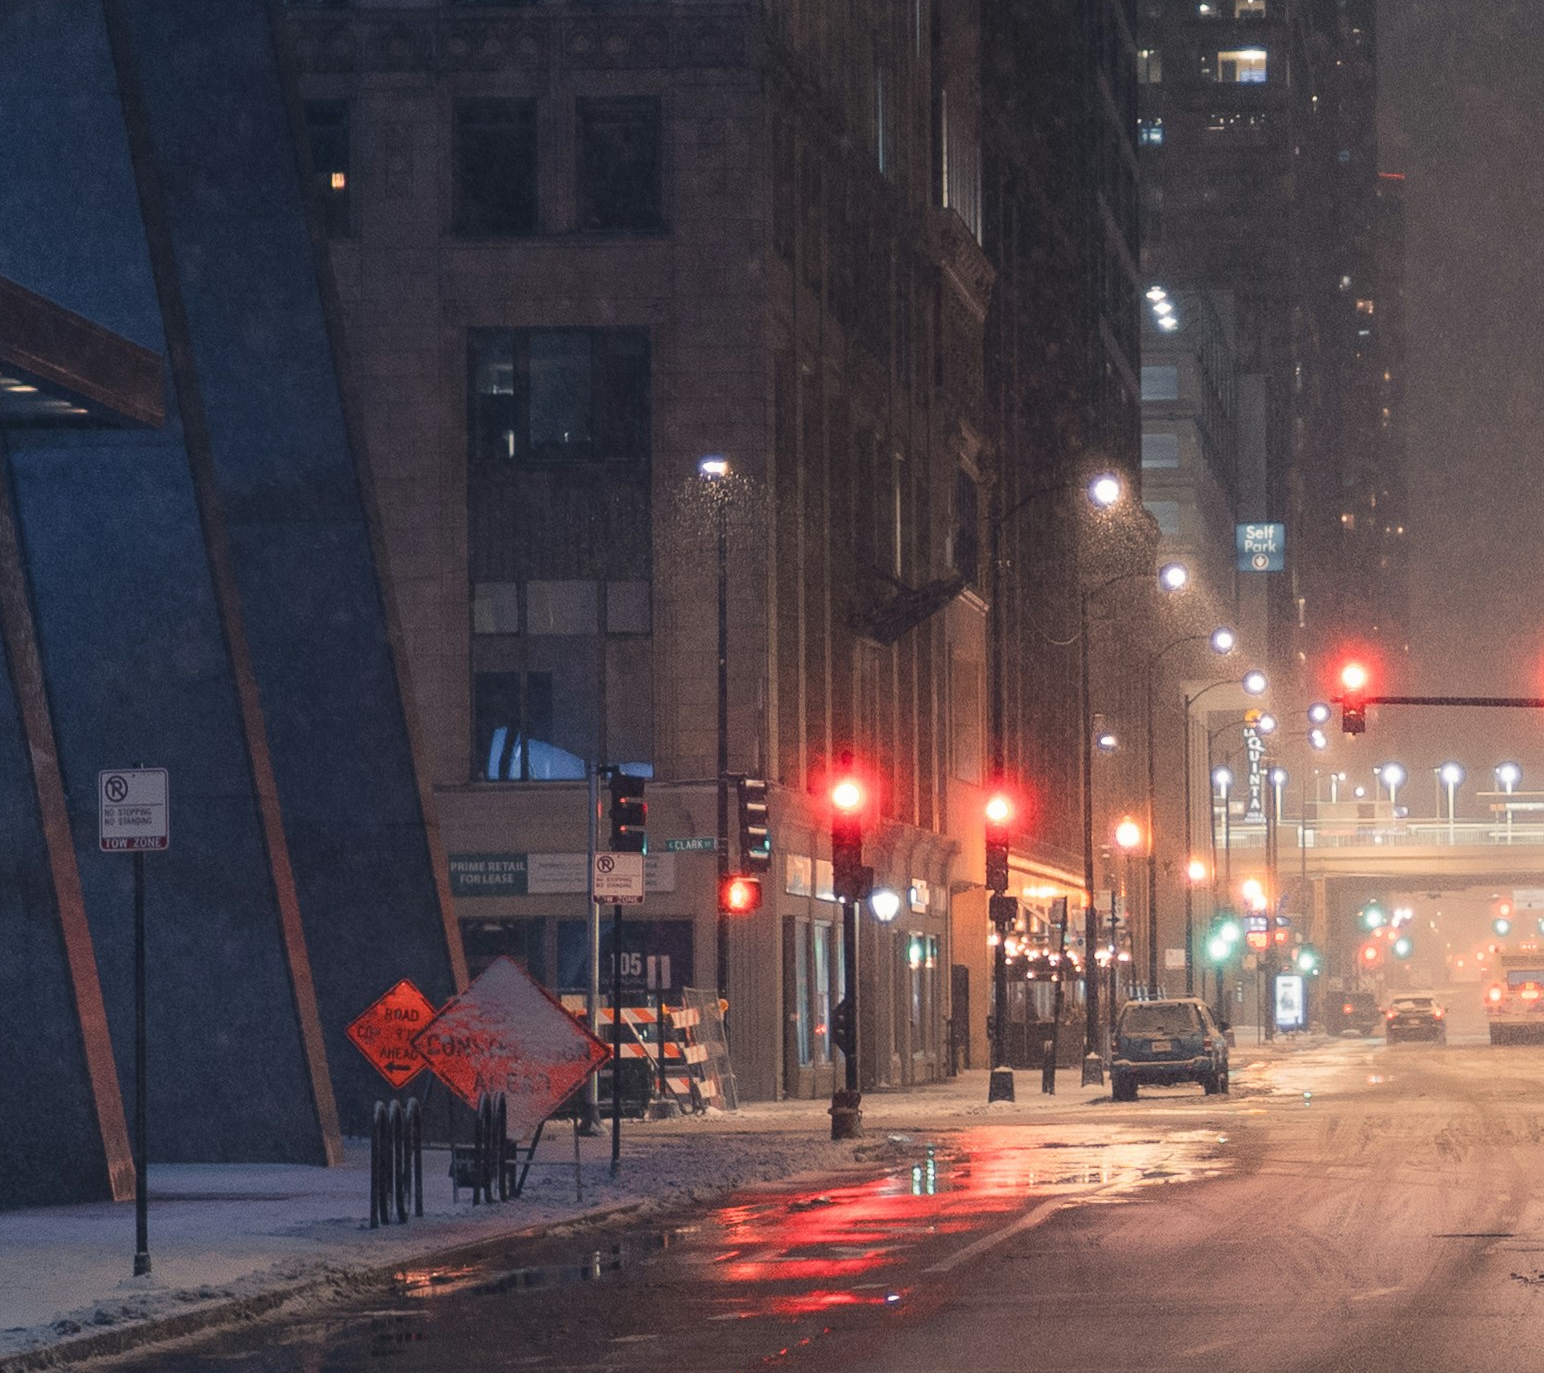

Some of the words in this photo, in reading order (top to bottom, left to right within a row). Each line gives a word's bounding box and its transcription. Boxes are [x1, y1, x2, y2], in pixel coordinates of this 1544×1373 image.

[1246, 525, 1274, 539] Self
[1244, 539, 1276, 553] Park
[1247, 736, 1266, 809] QUINTA
[106, 838, 127, 848] TOW
[134, 837, 161, 848] ZONE
[675, 839, 703, 850] CLARK
[450, 861, 485, 872] PRIME
[488, 861, 526, 871] RETAIL
[460, 874, 481, 884] FOR
[485, 874, 514, 884] LEASE
[610, 952, 642, 976] 105
[385, 1008, 419, 1022] ROAD
